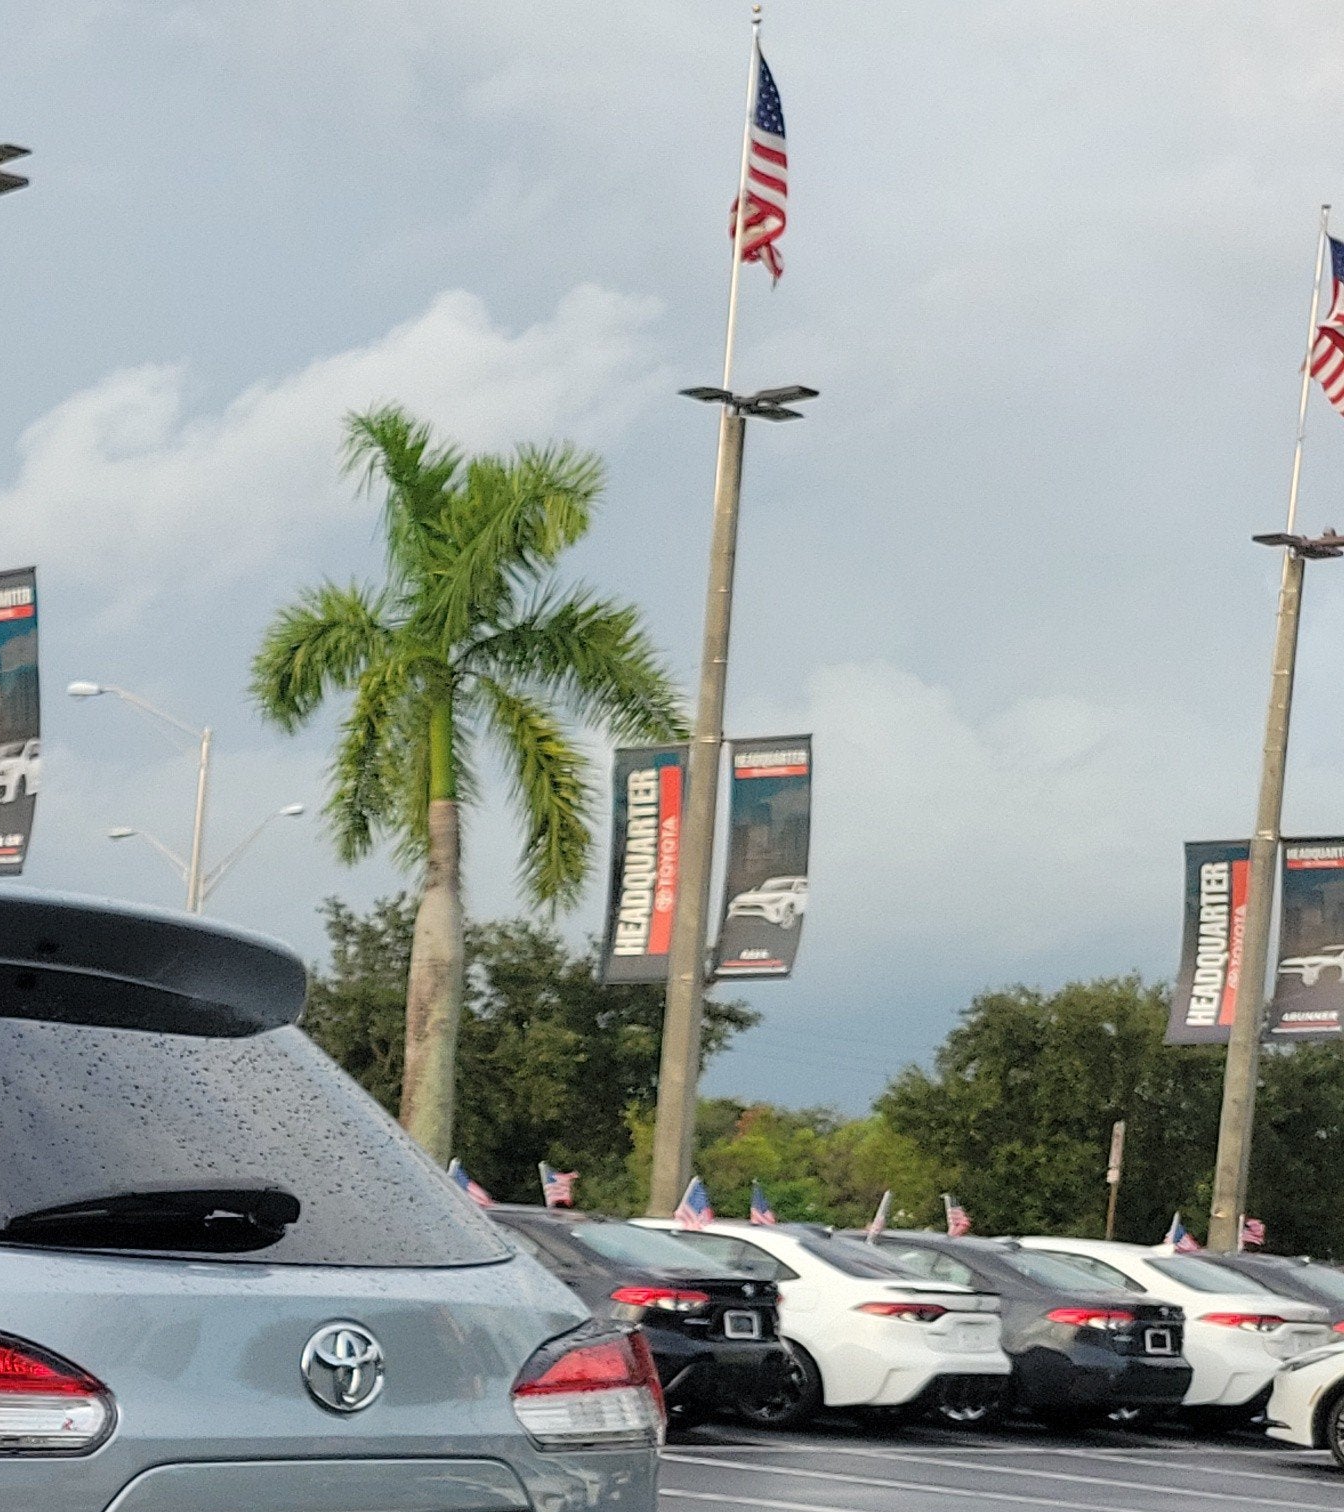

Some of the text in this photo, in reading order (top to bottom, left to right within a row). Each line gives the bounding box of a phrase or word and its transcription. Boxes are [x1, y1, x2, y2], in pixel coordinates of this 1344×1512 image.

[613, 768, 659, 955] HEADQUARTER
[658, 816, 681, 882] TOYOTA
[1185, 861, 1230, 1026] HEADQUARTER
